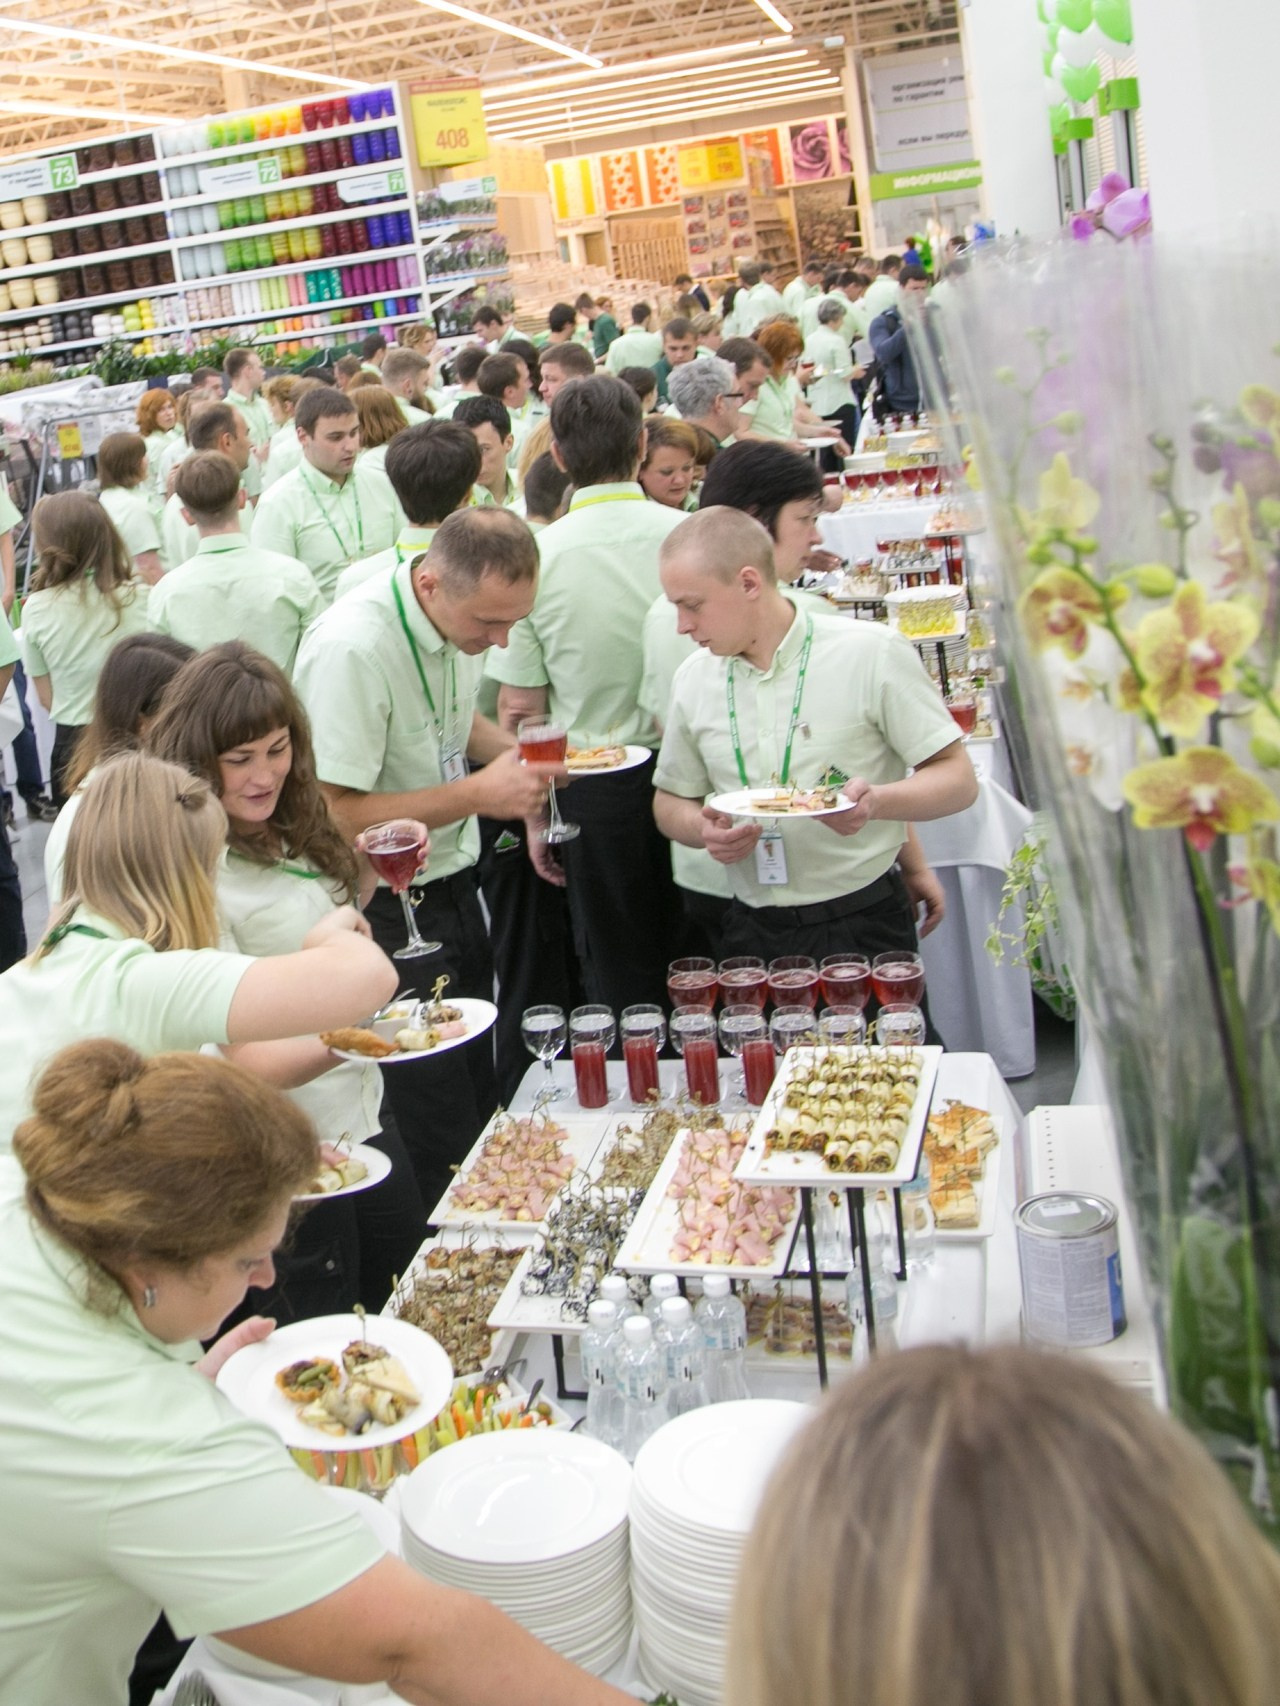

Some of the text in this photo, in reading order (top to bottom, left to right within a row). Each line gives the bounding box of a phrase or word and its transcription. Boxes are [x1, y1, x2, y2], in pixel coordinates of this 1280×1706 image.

[436, 128, 469, 149] 408
[53, 165, 74, 186] 73
[260, 166, 279, 182] 72
[390, 177, 405, 192] 71
